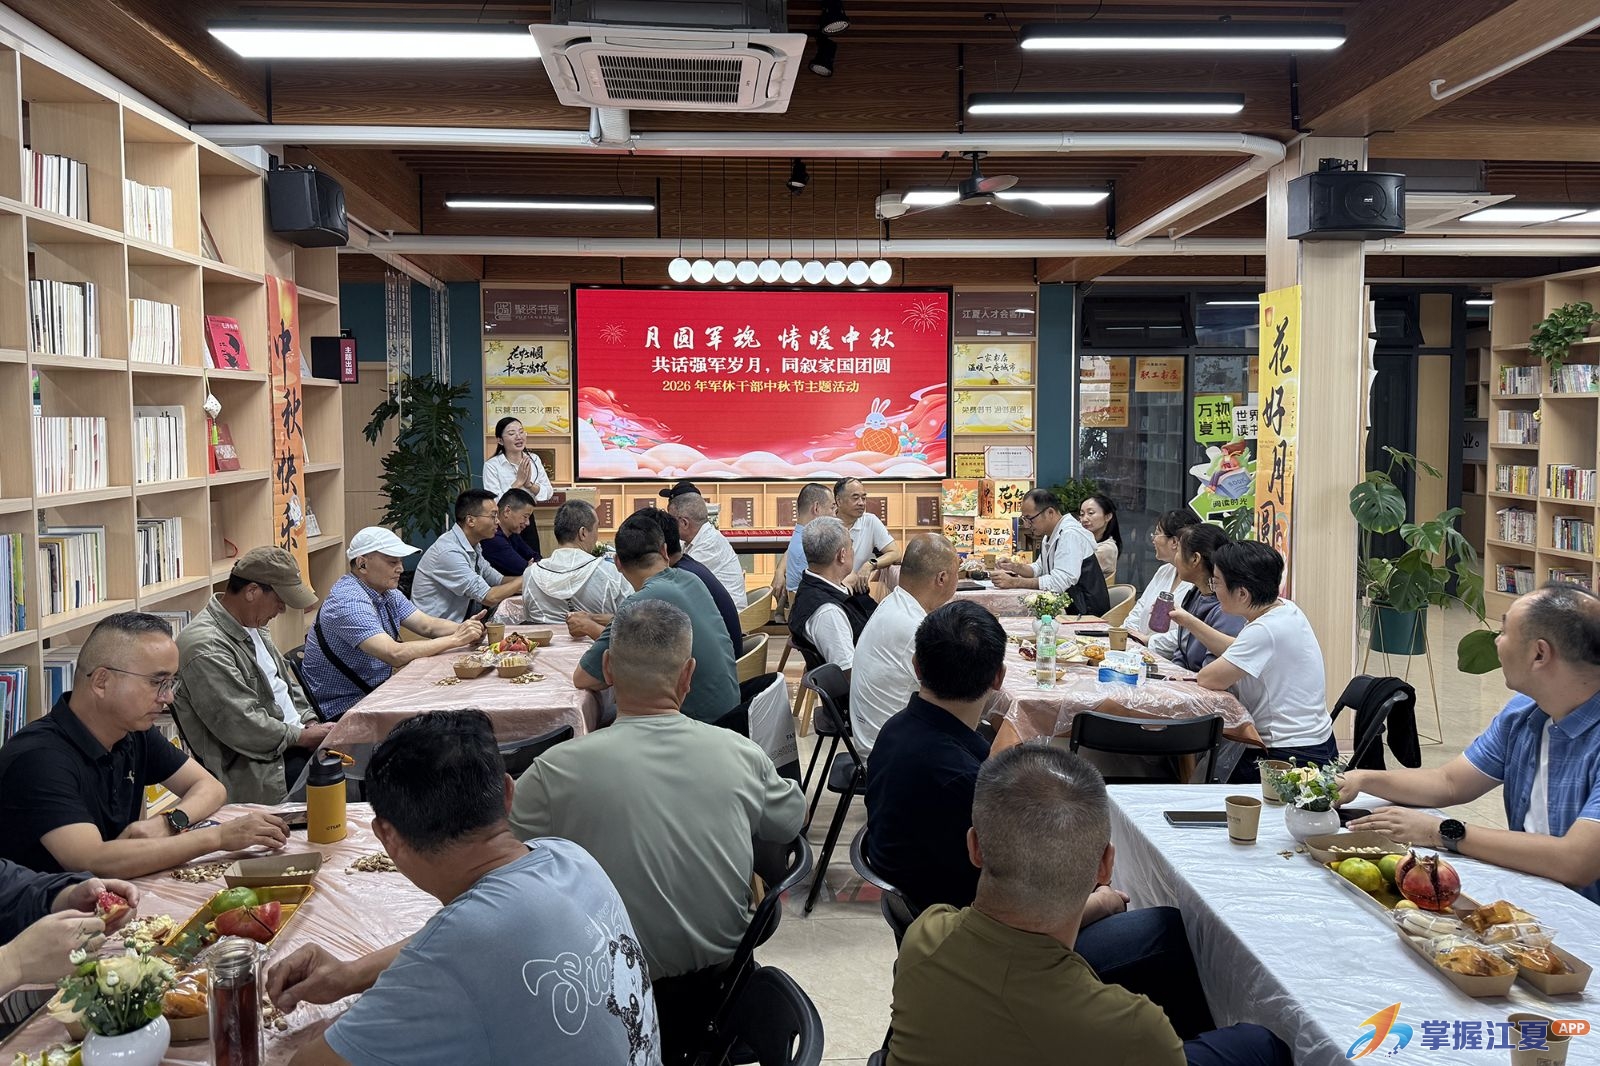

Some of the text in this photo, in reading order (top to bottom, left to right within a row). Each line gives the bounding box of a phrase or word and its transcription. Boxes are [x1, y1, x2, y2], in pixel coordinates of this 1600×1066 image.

[644, 325, 896, 351] 月圆军魂 情暖中秋
[651, 356, 891, 374] 共话强军岁月，同叙家国团圆
[662, 379, 859, 393] 2026 年军休干部中秋节主题活动
[1197, 402, 1231, 417] 万物
